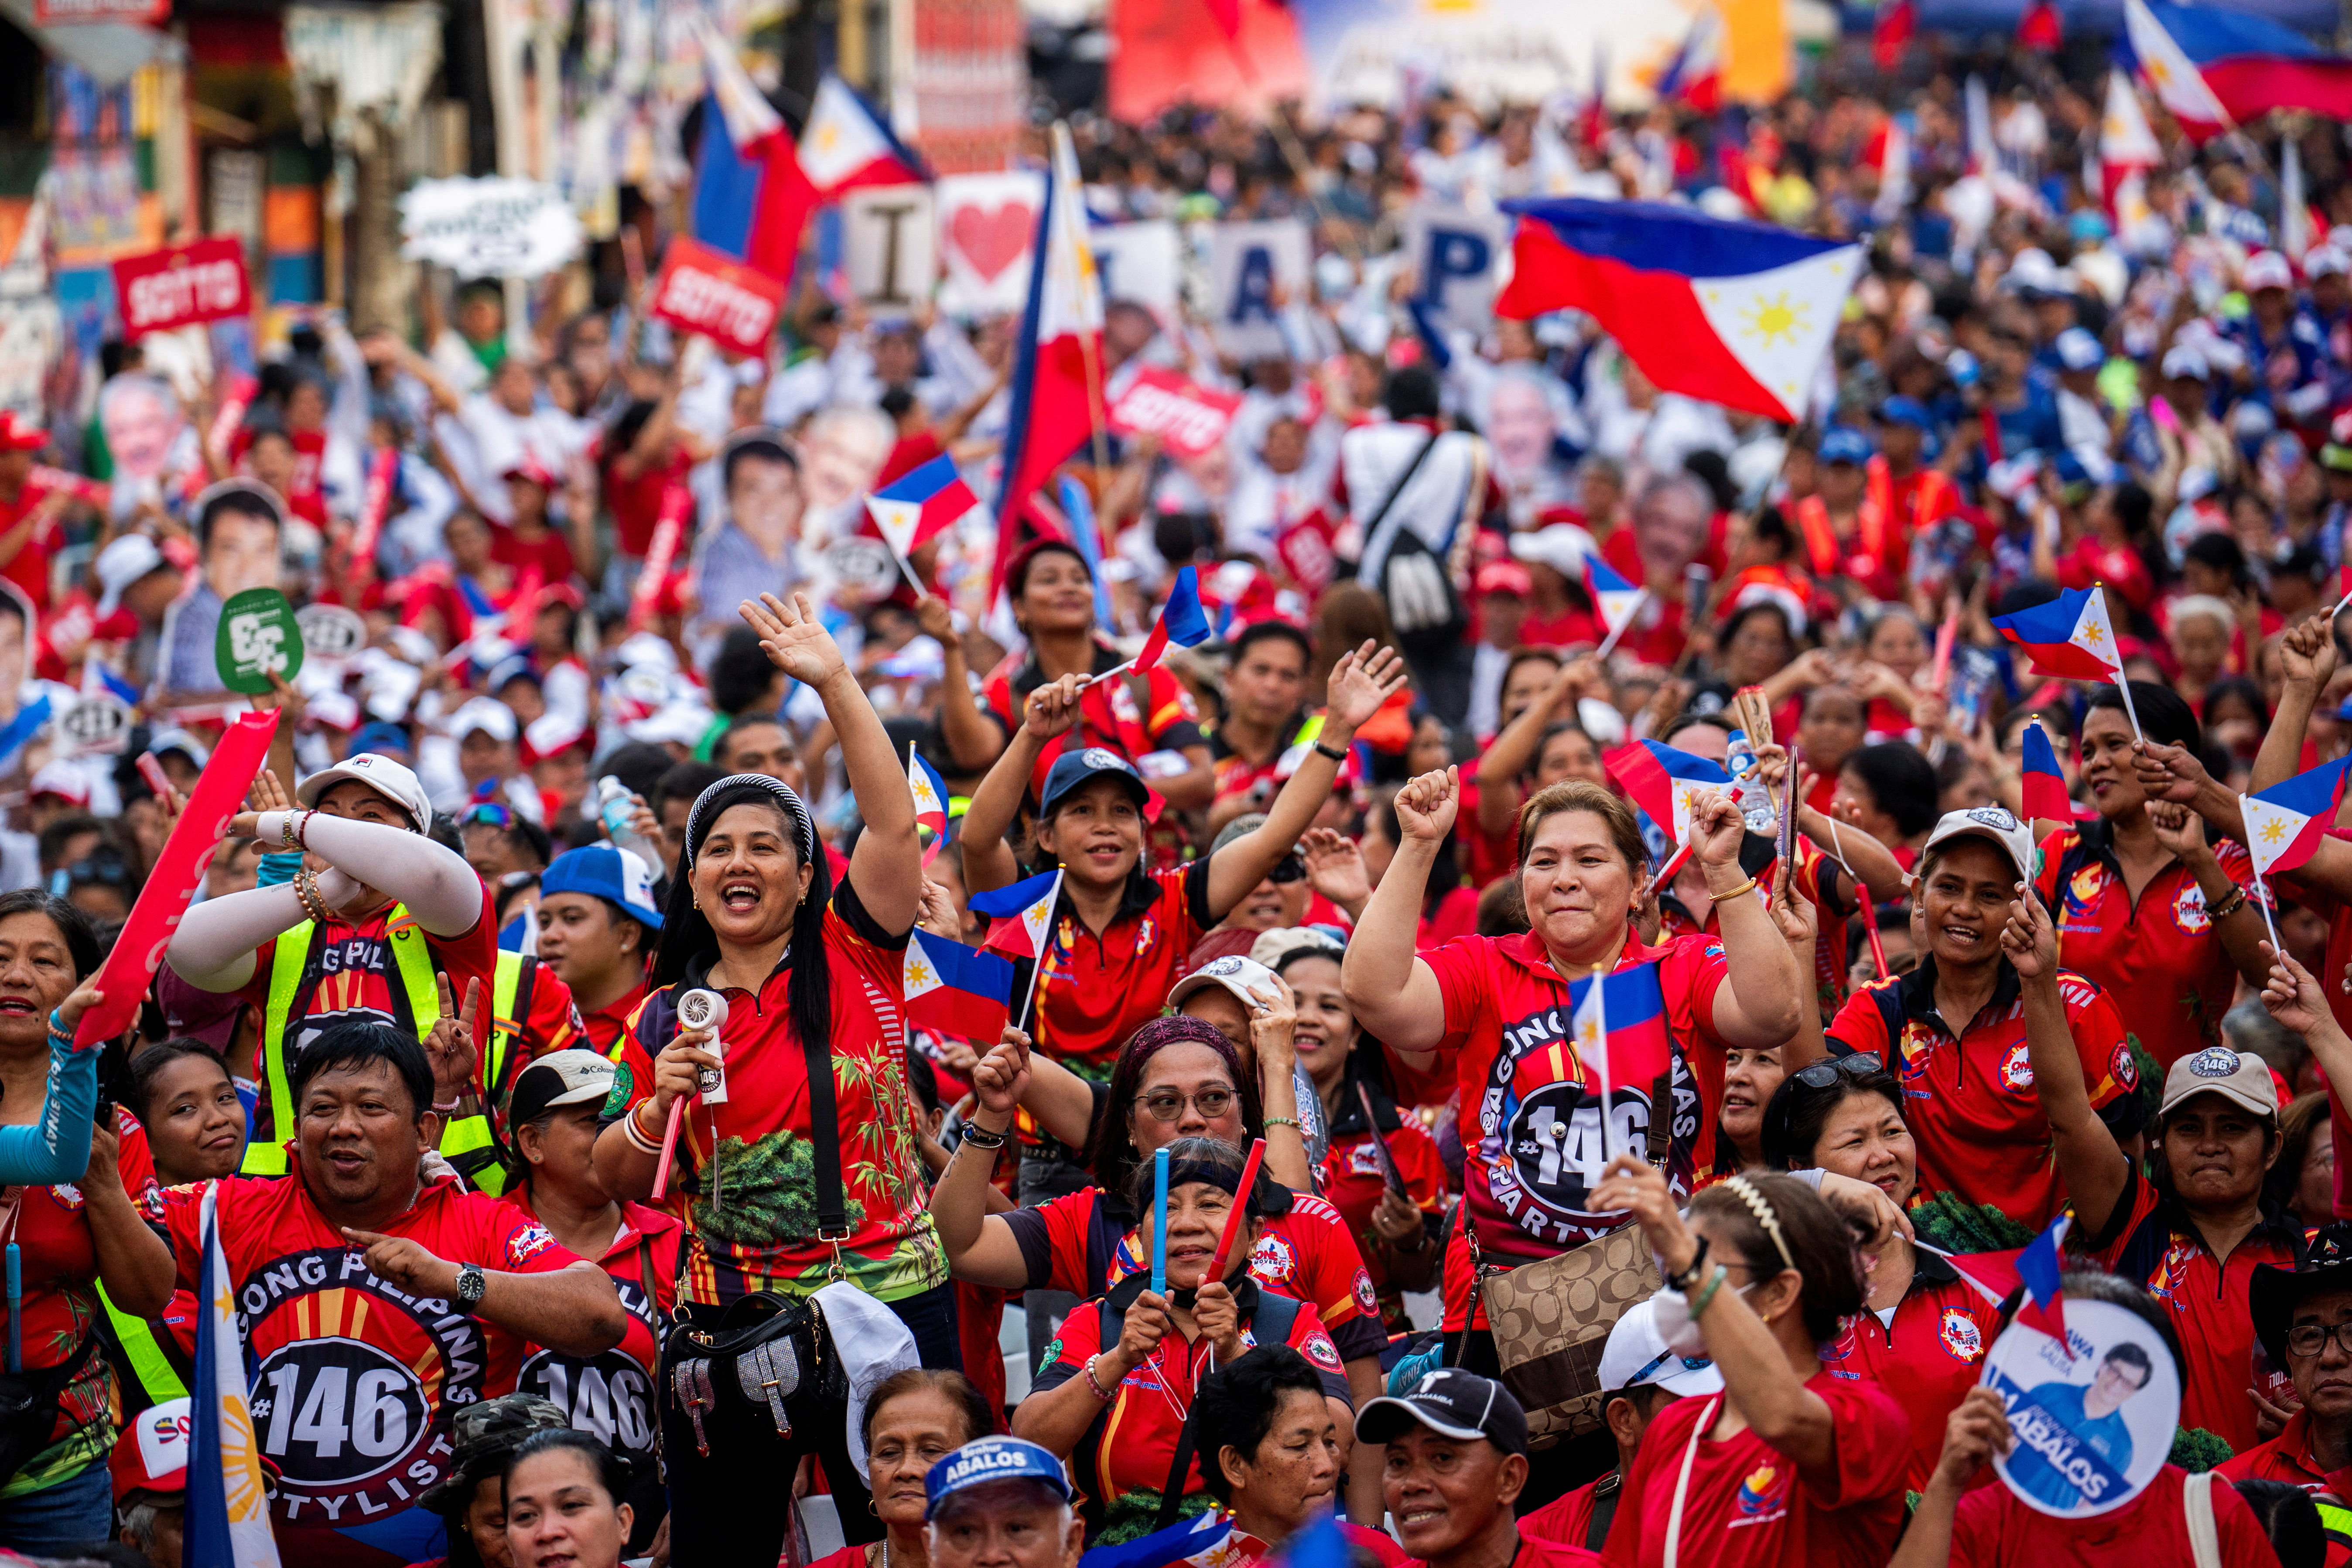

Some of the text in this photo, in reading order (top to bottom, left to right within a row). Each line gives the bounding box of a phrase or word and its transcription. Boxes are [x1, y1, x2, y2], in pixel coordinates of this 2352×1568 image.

[1420, 229, 1490, 311] P
[590, 1064, 615, 1075] Colum
[699, 1070, 716, 1084] 146
[2011, 1061, 2031, 1071] ON
[1255, 1250, 1278, 1260] ONE
[2066, 1329, 2094, 1360] AWA
[537, 1363, 652, 1449] 146
[946, 1451, 1027, 1484] ABALOS
[2007, 1410, 2109, 1499] ABALOS
